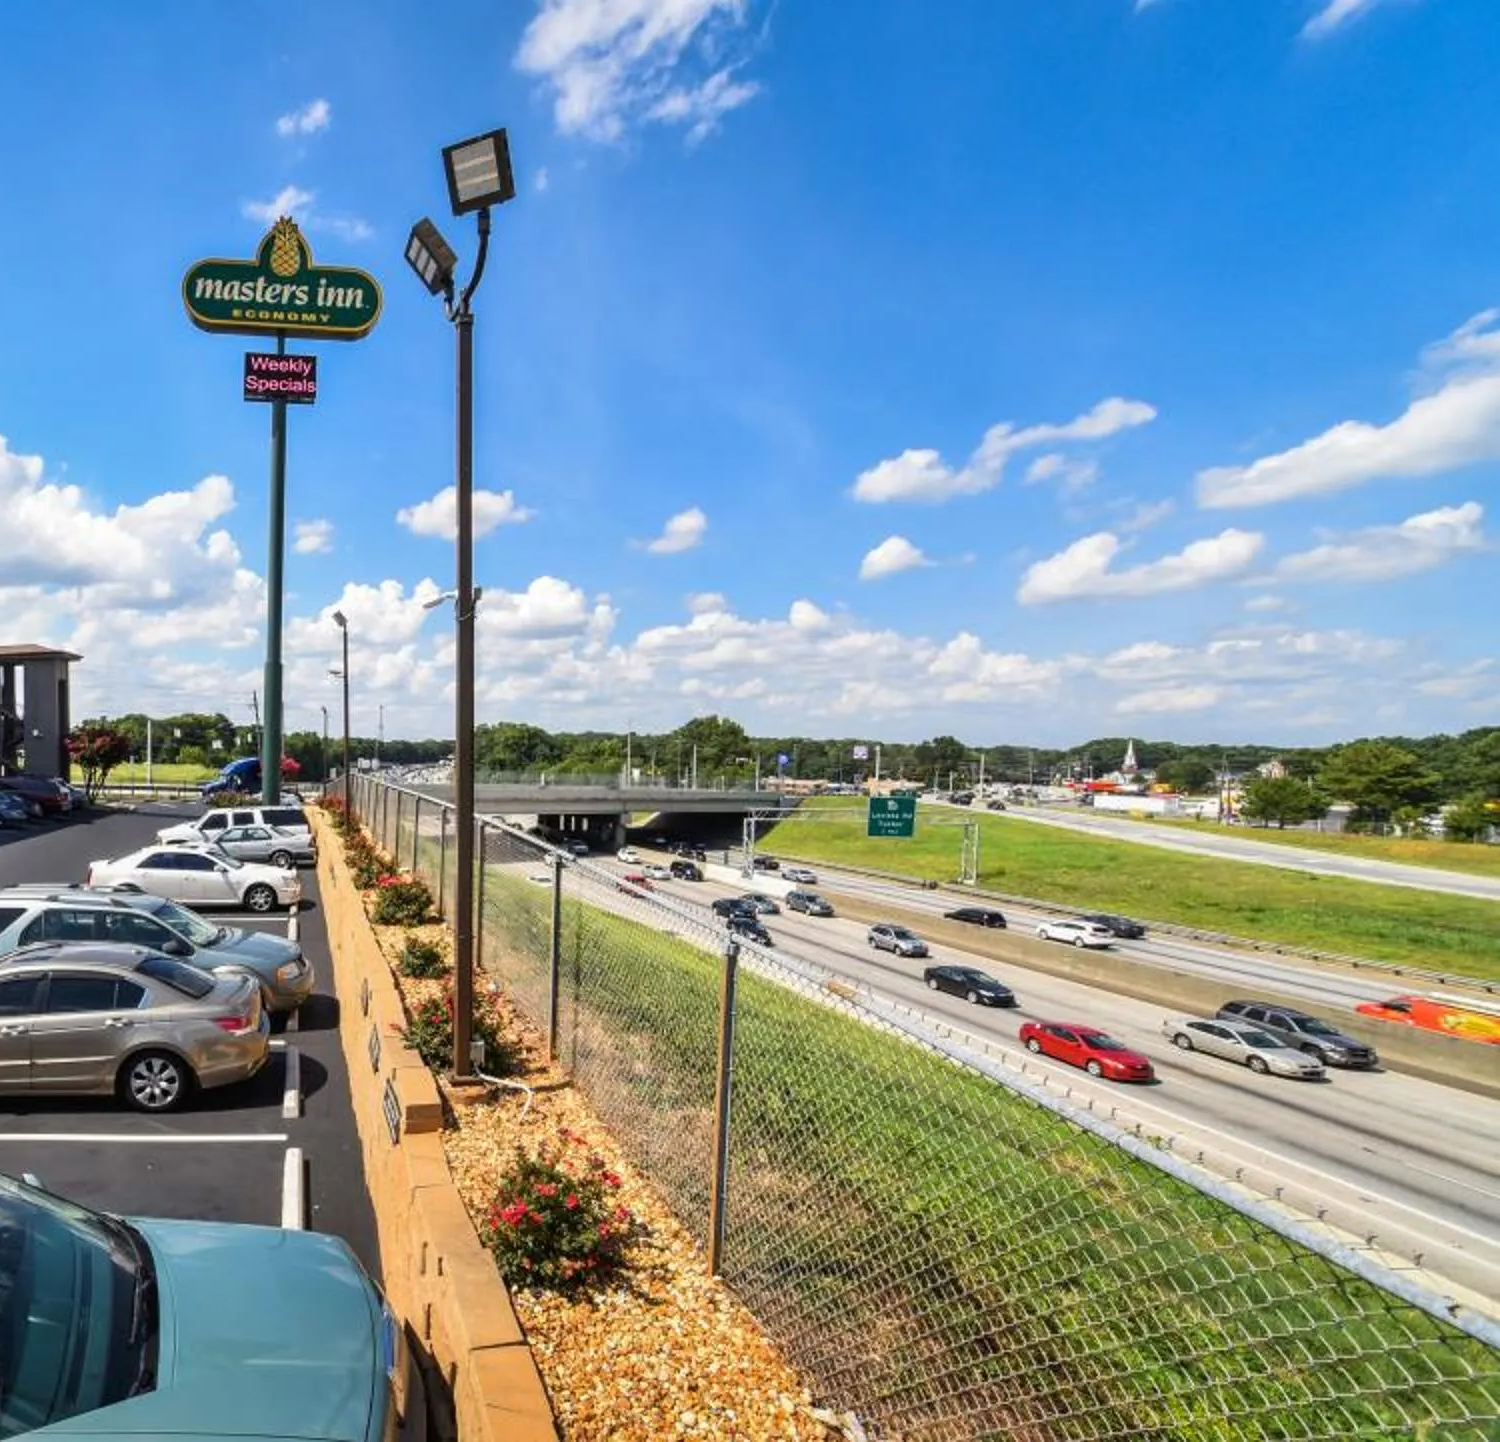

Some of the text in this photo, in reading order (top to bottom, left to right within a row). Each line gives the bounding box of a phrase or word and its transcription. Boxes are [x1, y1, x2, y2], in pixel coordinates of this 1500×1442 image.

[194, 276, 365, 309] masters inn
[231, 308, 331, 323] ECONOMY
[251, 356, 312, 377] Weekly
[245, 375, 315, 393] Specials
